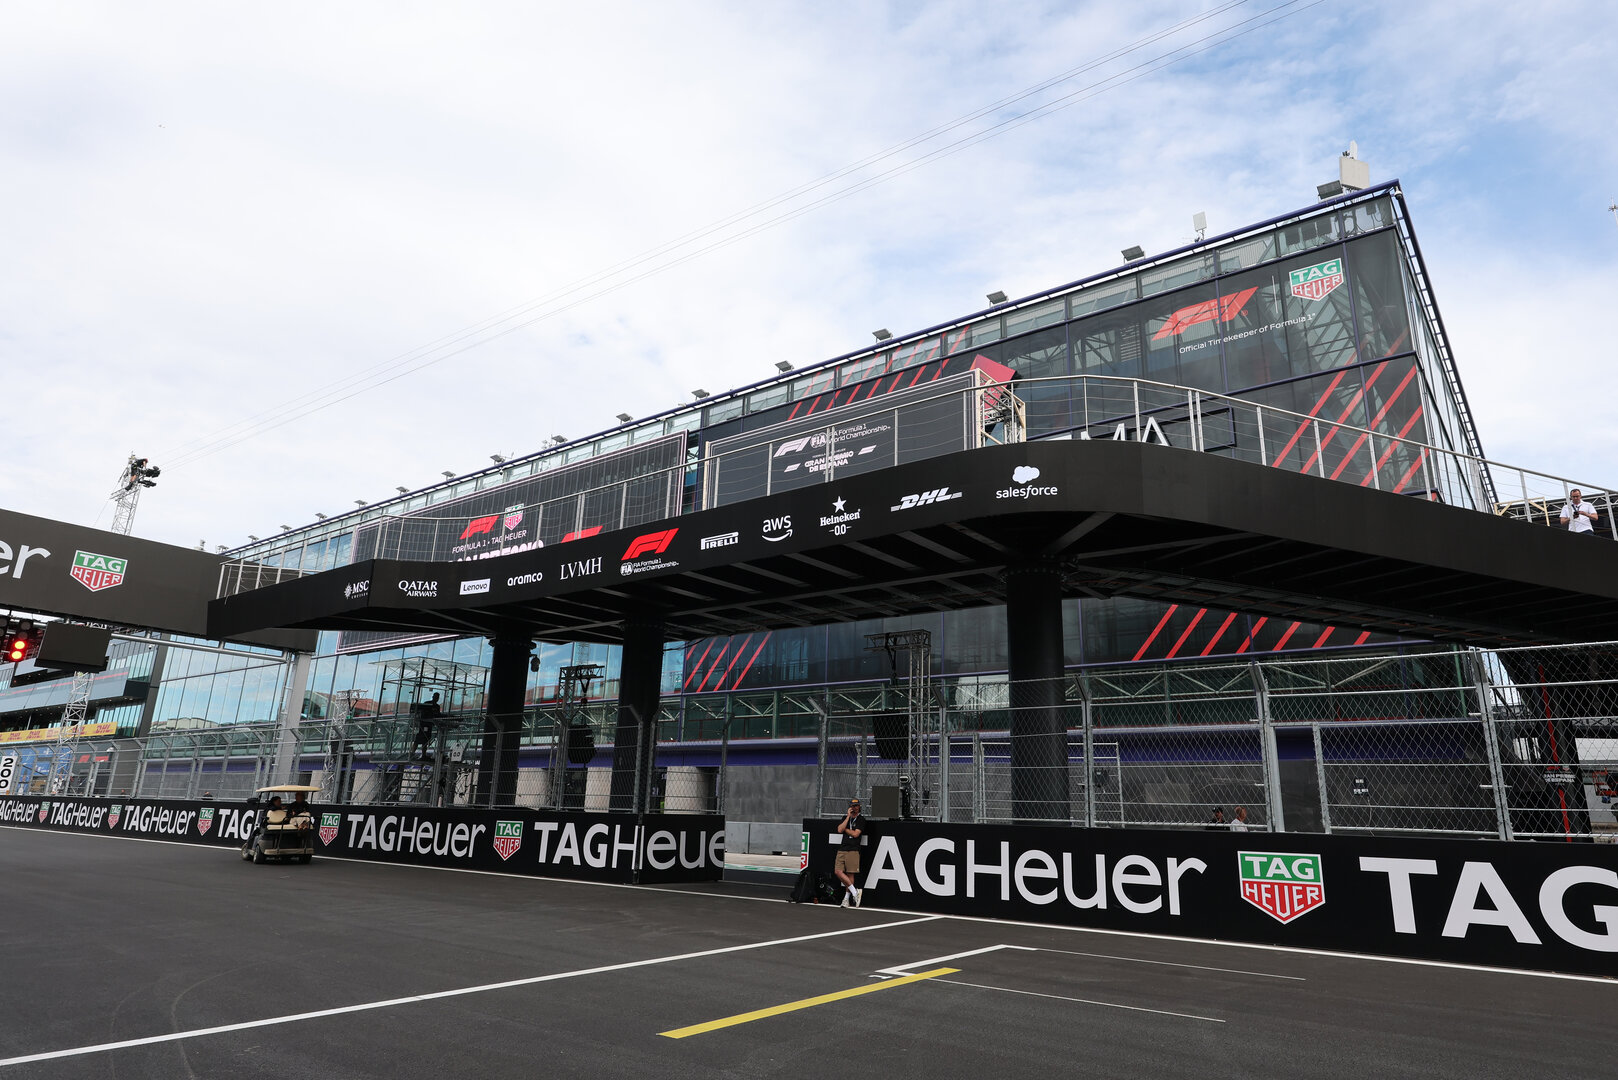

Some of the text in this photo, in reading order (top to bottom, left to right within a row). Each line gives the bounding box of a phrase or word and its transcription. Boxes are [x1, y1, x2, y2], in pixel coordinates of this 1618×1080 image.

[1293, 262, 1337, 283] TAG
[1294, 276, 1341, 299] HEUER
[1179, 341, 1207, 354] Official
[1259, 325, 1269, 335] of
[1269, 316, 1306, 331] Formula
[829, 434, 846, 444] orld
[839, 425, 863, 436] Formula
[900, 487, 952, 510] DHL
[996, 485, 1058, 500] salesforce
[762, 515, 792, 533] aws
[820, 510, 861, 527] Heineken
[452, 541, 481, 554] FORMULA
[505, 530, 527, 541] HEUER
[700, 531, 739, 550] PIRELLI
[79, 553, 122, 572] TAG
[560, 557, 603, 580] LVMH
[74, 567, 121, 589] HEUER
[352, 580, 370, 594] MSC
[398, 580, 438, 591] QATAR
[463, 583, 488, 592] Lenovo
[507, 572, 543, 587] aramco
[407, 590, 438, 598] AIRWAYS
[0, 799, 39, 823] AGHeuer
[50, 802, 107, 828] TAGHeuer
[123, 805, 196, 835] TAGHeuer
[201, 809, 214, 819] TAG
[323, 815, 339, 826] TAG
[347, 814, 487, 858] TAGHeuer
[497, 823, 520, 835] TAG
[495, 838, 521, 858] HEUER
[1244, 856, 1315, 880] TAG
[1245, 883, 1321, 918] HEUER
[1359, 856, 1618, 953] TAG
